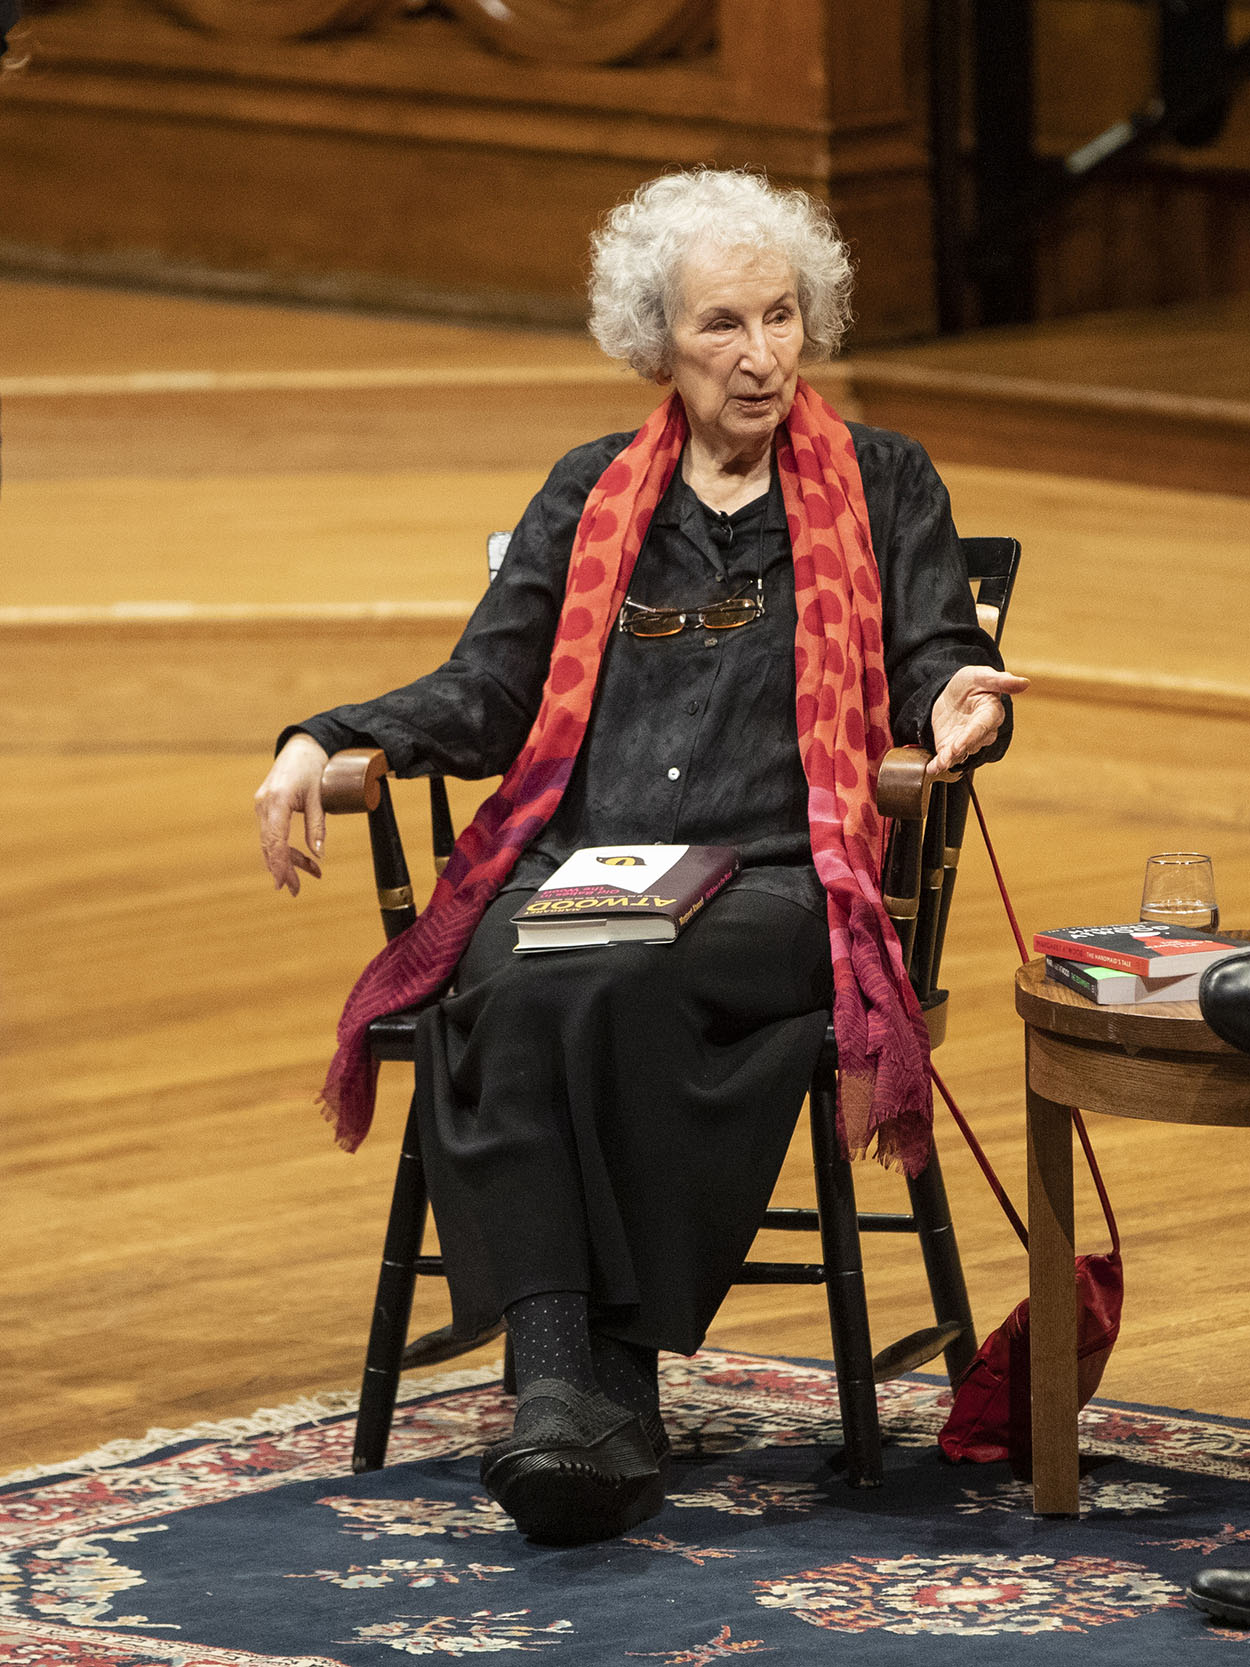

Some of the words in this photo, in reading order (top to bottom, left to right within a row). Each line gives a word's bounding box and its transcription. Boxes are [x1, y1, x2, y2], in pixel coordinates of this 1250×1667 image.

[526, 897, 677, 911] ATWOOD
[1087, 951, 1095, 959] THE
[1095, 953, 1121, 966] HANDMAID'S
[1121, 958, 1132, 968] TALE
